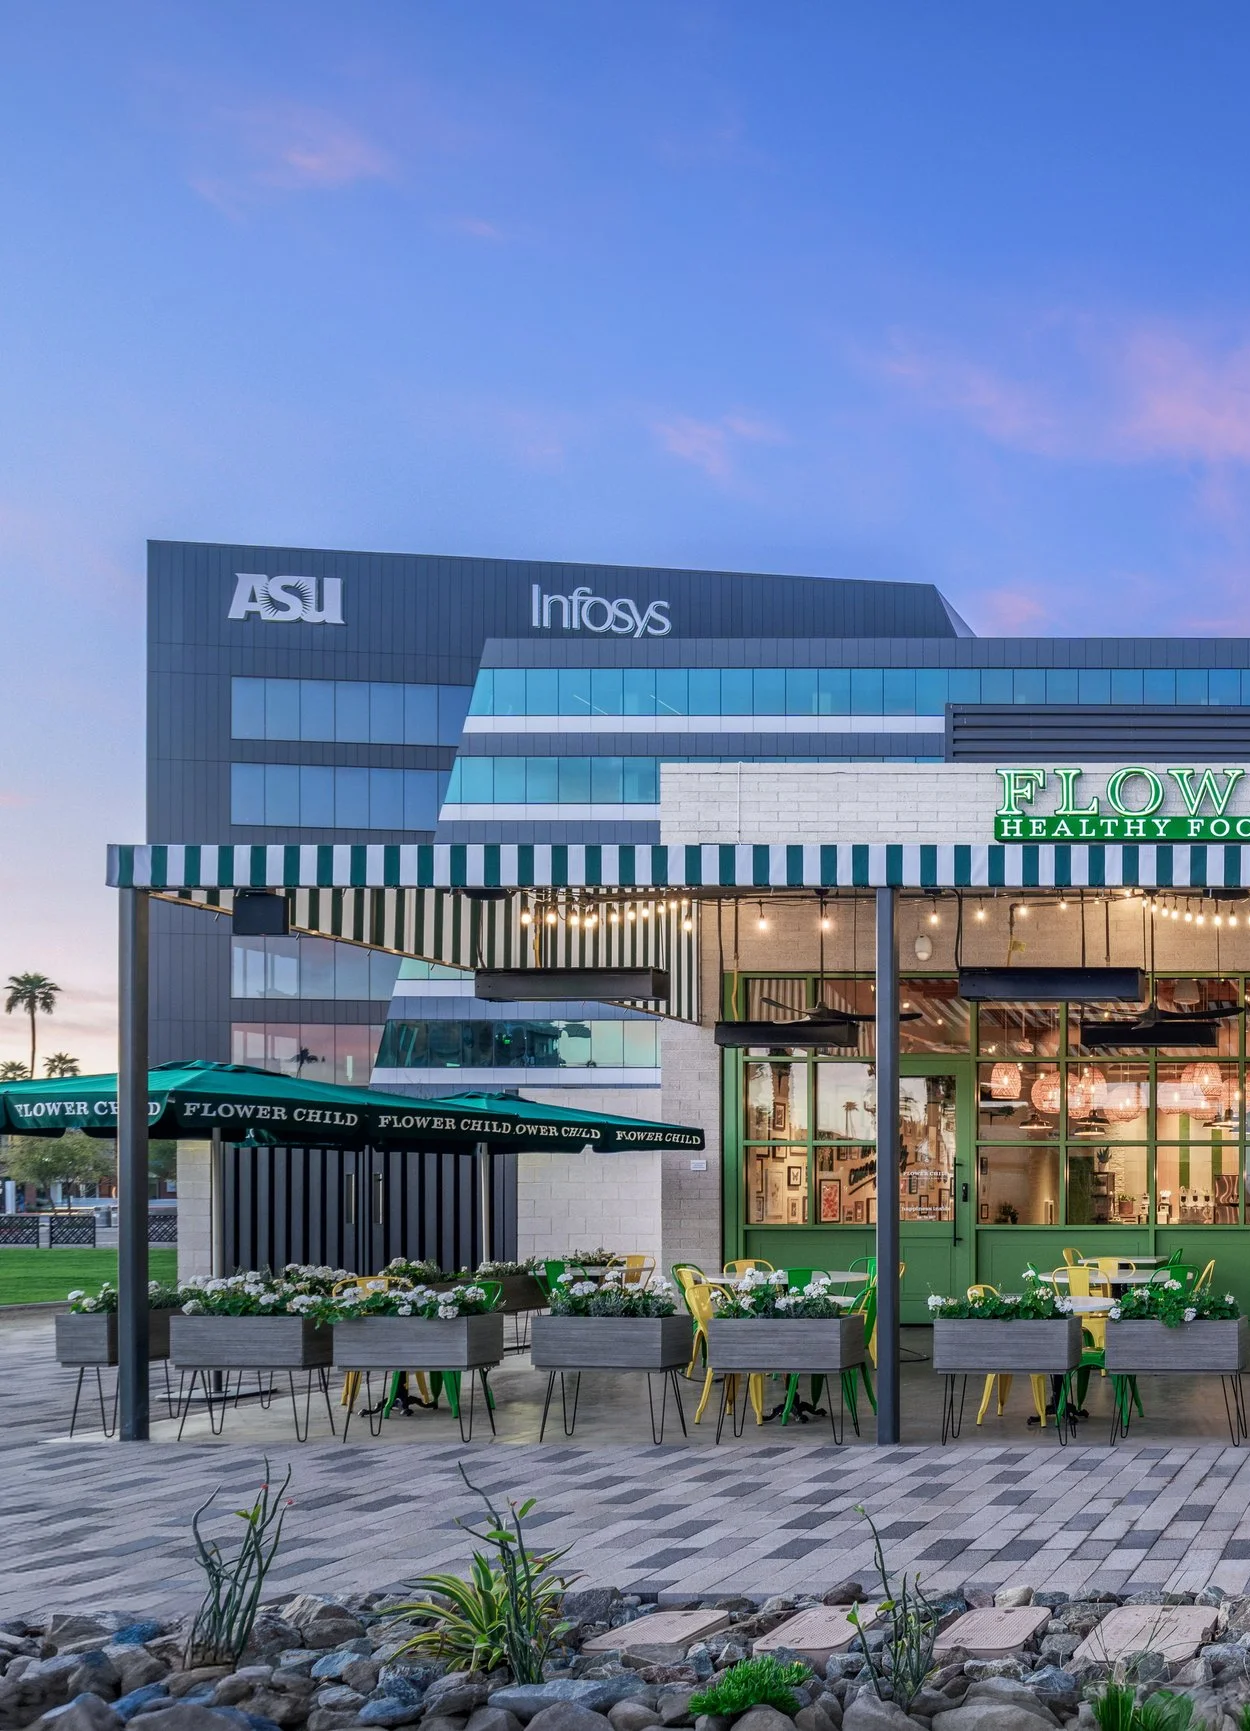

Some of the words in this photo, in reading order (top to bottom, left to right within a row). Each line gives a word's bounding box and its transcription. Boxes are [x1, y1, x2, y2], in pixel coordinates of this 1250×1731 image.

[227, 573, 346, 625] ASU
[532, 584, 672, 638] Infosys
[1000, 818, 1170, 838] HEALTHY
[14, 1101, 90, 1118] FLOWER
[93, 1101, 161, 1116] CHD
[183, 1102, 288, 1120] FLOWER
[293, 1108, 359, 1126] CHILD
[378, 1115, 457, 1130] FLOWER
[460, 1118, 511, 1134] CHILD
[513, 1123, 559, 1137] OWER
[560, 1125, 601, 1139] CHILD
[664, 1133, 701, 1146] CHILD
